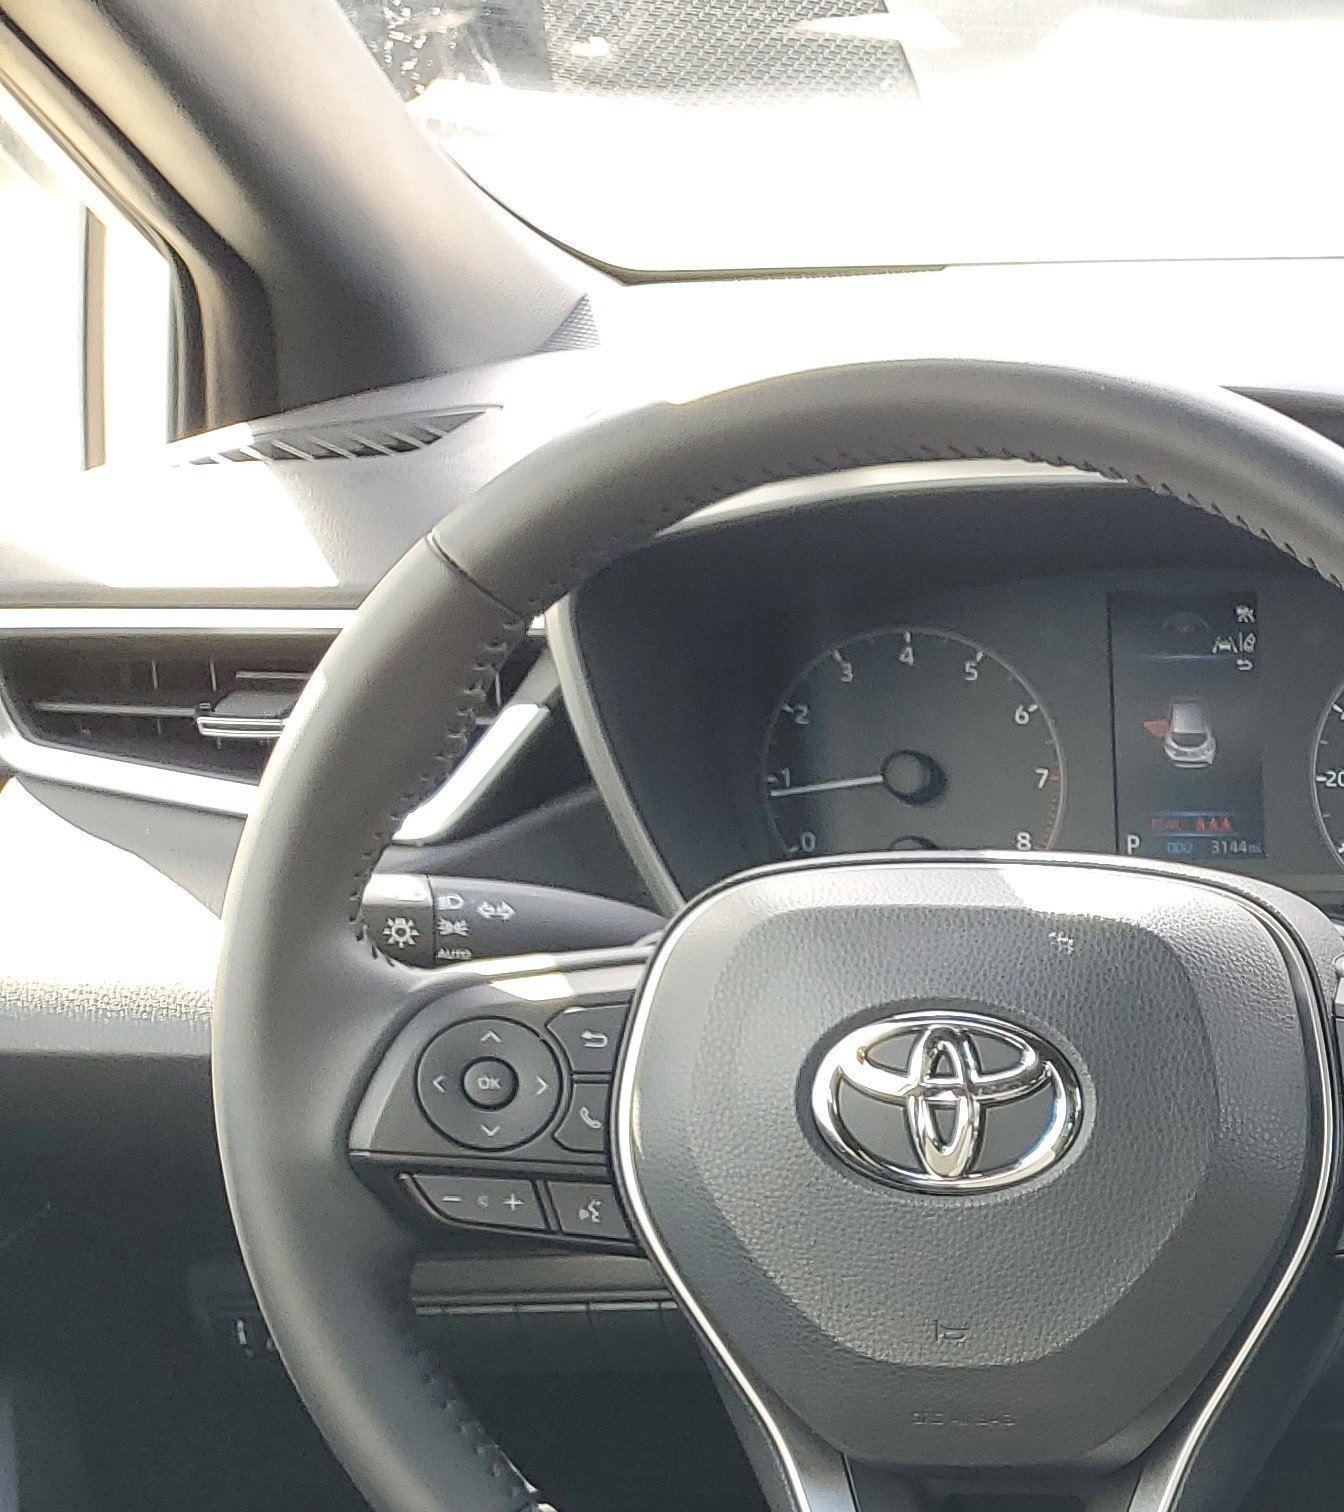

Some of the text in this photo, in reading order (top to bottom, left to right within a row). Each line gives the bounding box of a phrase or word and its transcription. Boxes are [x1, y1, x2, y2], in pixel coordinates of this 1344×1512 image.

[900, 648, 915, 666] 4
[841, 663, 854, 682] 3
[965, 662, 978, 681] 5
[795, 704, 810, 724] 2
[1015, 705, 1030, 724] 6
[1036, 768, 1050, 788] 7
[801, 831, 816, 850] 0
[1016, 832, 1032, 850] 8
[1127, 835, 1141, 855] P
[478, 1077, 502, 1091] OK
